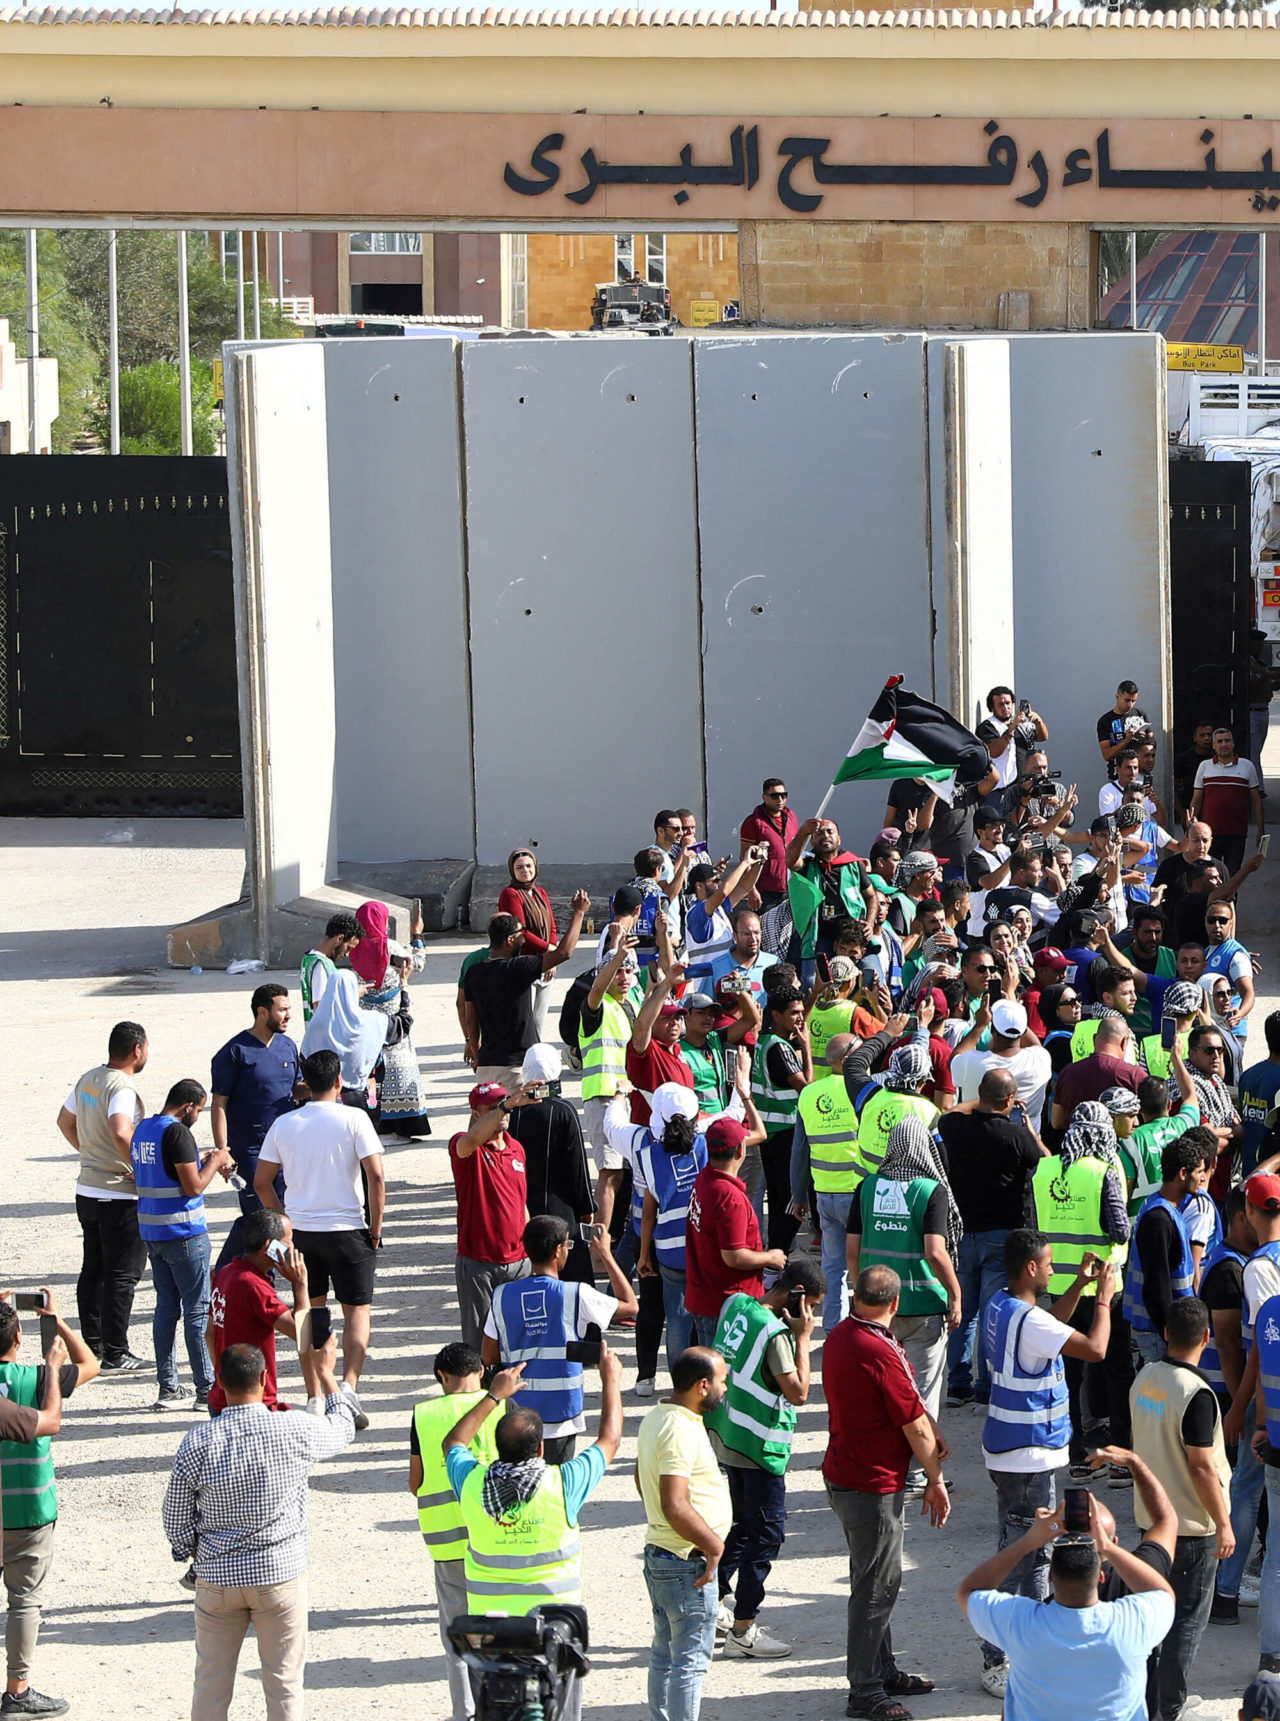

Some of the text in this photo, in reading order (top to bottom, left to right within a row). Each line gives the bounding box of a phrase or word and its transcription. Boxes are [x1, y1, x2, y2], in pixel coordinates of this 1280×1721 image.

[503, 123, 759, 206] البرى
[776, 119, 1050, 213] رفح
[1200, 361, 1216, 369] Park
[874, 1220, 908, 1232] متطوع
